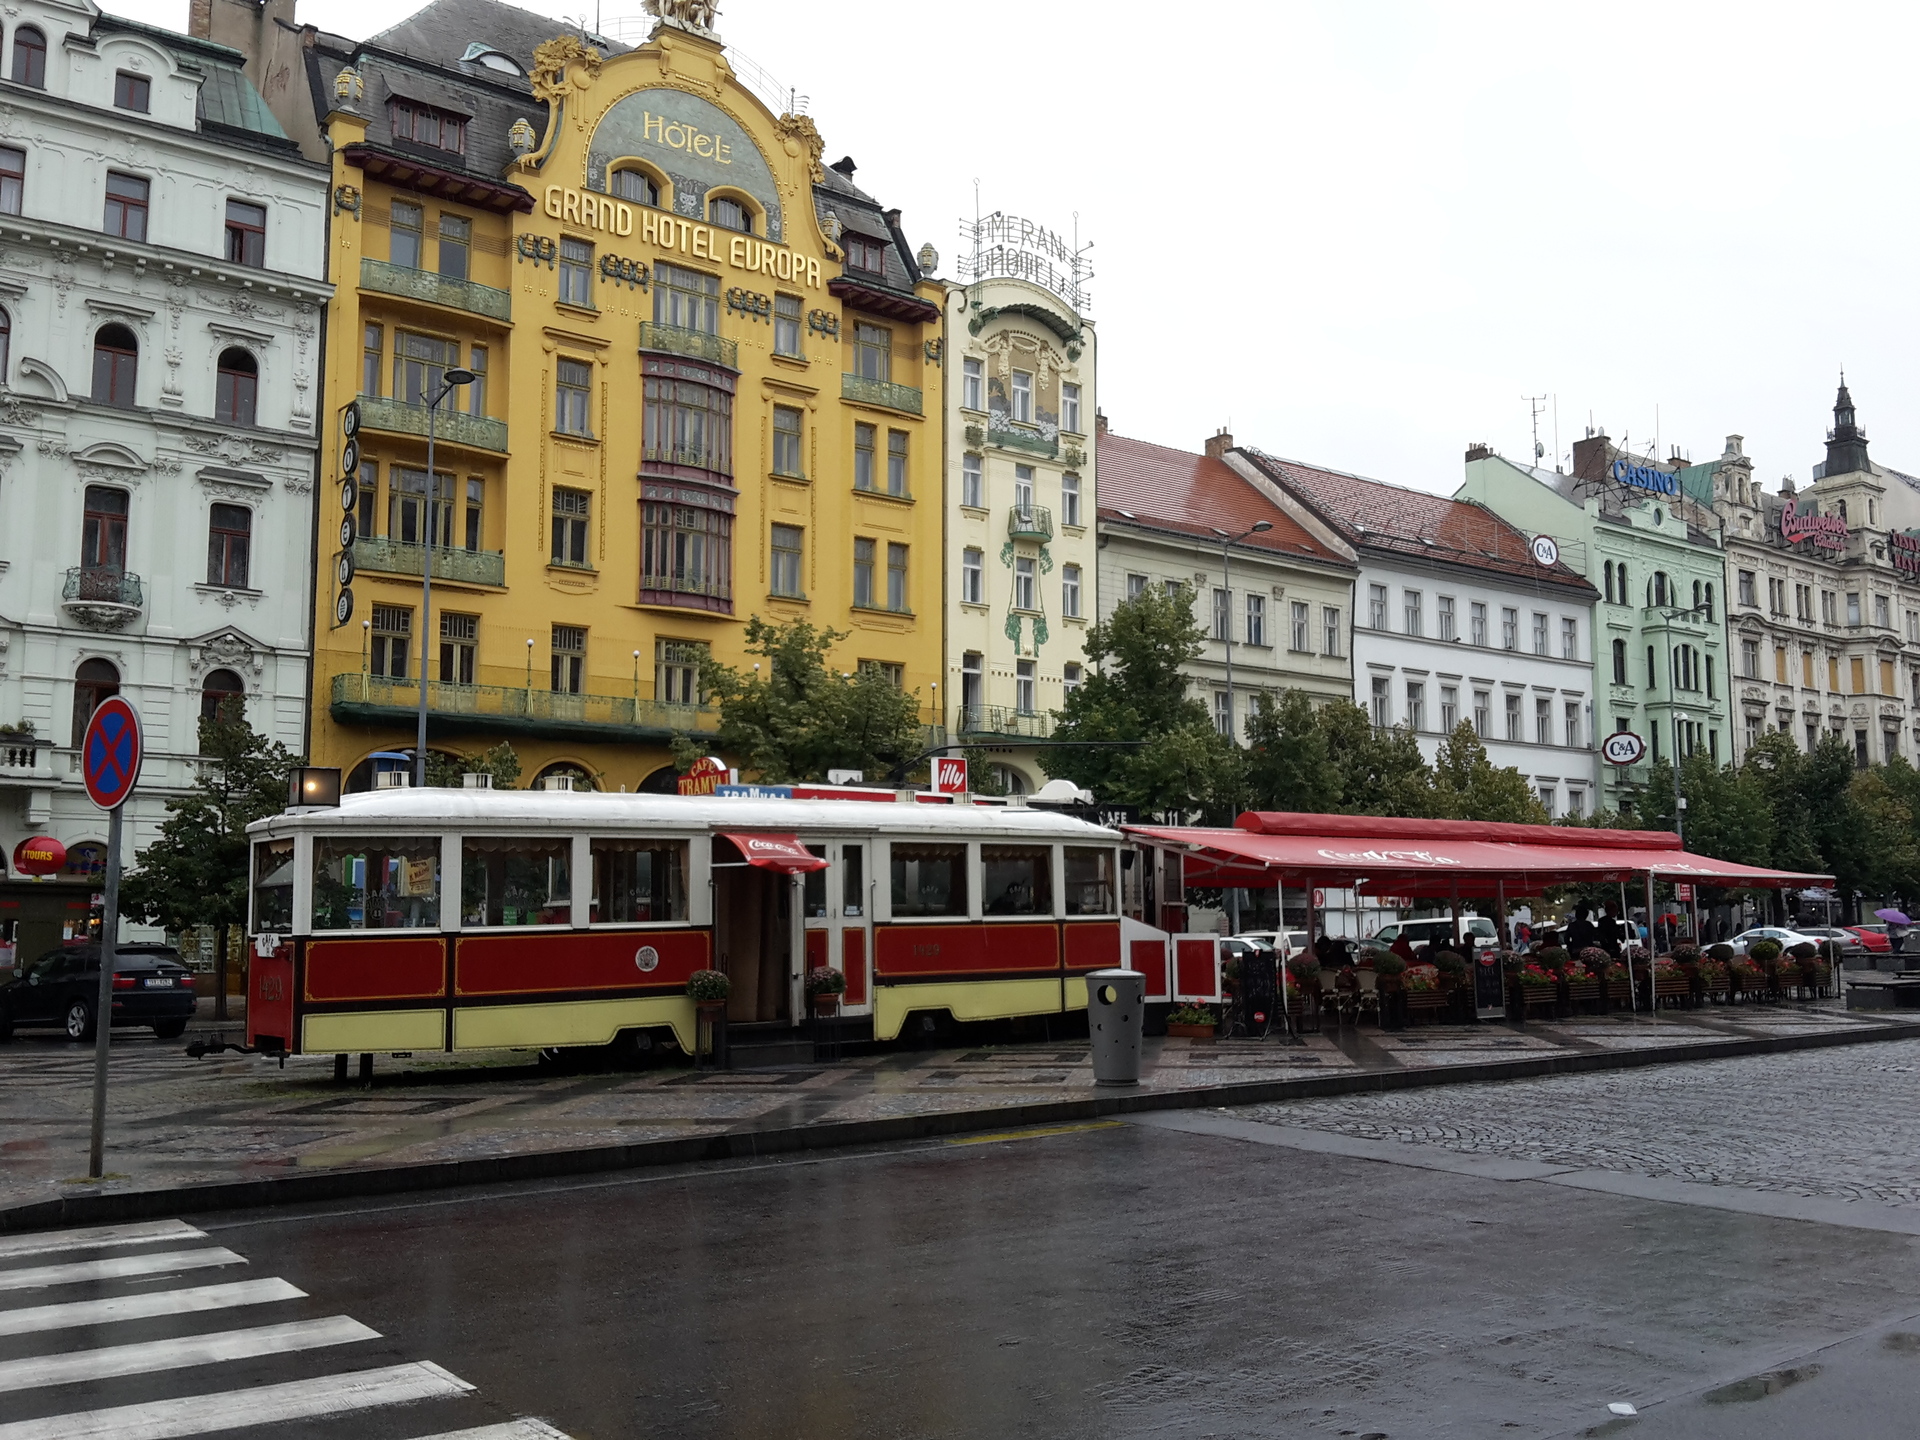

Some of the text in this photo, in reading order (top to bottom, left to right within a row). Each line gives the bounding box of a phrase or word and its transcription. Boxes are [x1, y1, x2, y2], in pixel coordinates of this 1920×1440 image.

[544, 184, 821, 289] GRAND HOTEL EUROPA
[991, 214, 1063, 263] MERAN
[990, 248, 1062, 296] HOTEL
[1613, 460, 1677, 496] CASINO
[1781, 499, 1851, 539] Budweiser
[1536, 543, 1554, 560] C&A
[1609, 740, 1636, 757] C&A
[939, 763, 965, 791] illy
[27, 850, 53, 861] TOURS
